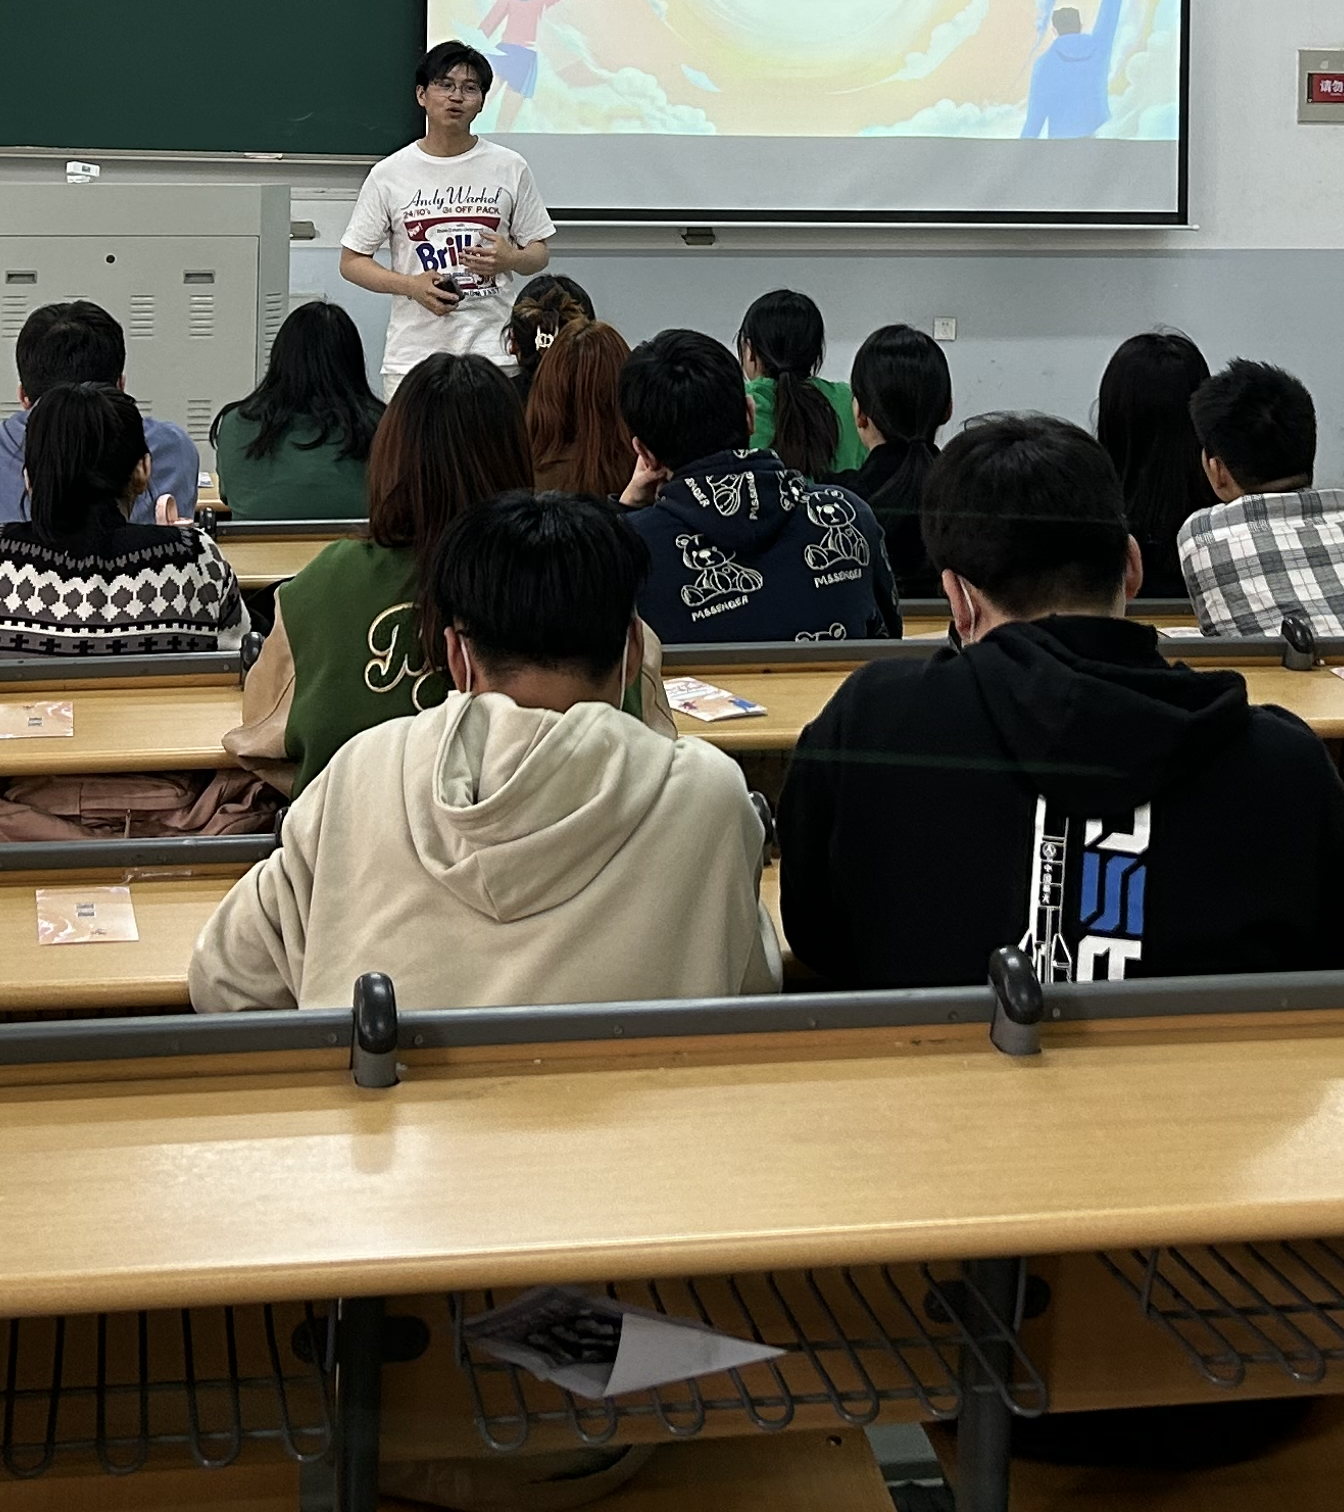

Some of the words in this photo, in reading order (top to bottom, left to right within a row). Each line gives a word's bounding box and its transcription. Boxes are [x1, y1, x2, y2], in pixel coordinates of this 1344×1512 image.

[400, 188, 445, 210] Andy
[446, 185, 503, 205] Warhol
[455, 206, 473, 214] OFF
[476, 206, 501, 215] PACK
